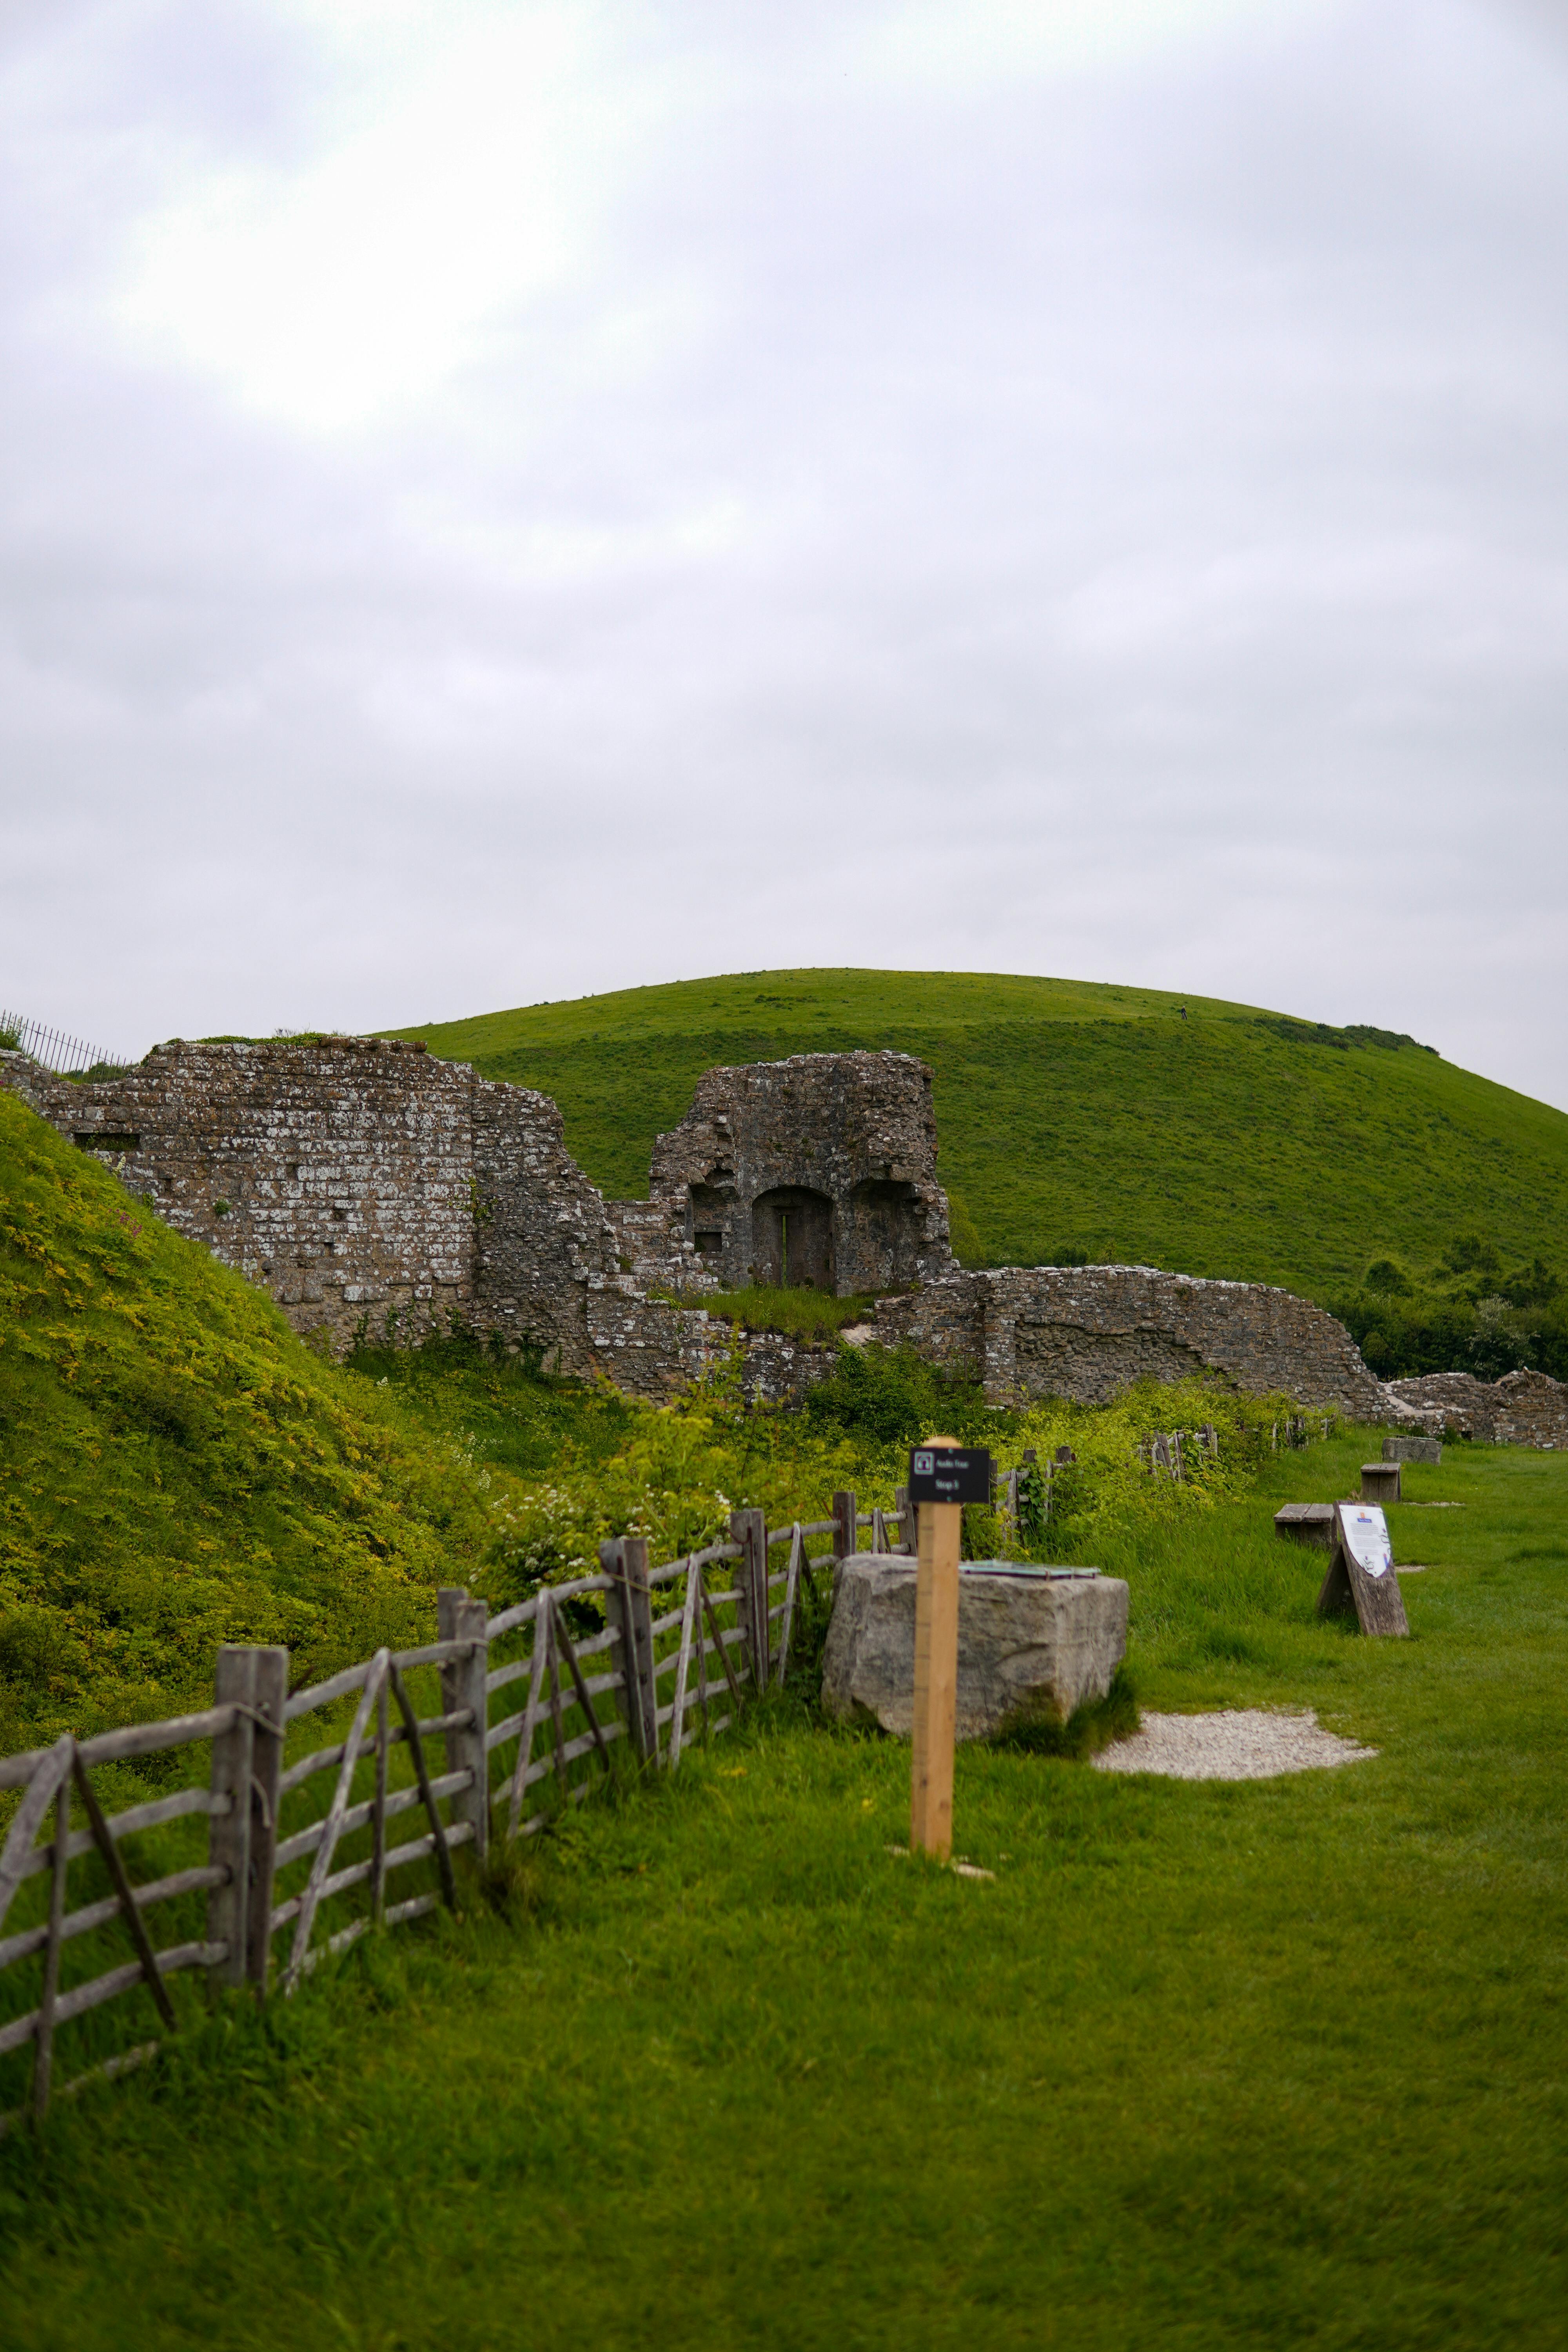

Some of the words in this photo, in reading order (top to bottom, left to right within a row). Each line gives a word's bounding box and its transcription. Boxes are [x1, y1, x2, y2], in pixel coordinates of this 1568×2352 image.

[936, 1459, 953, 1468] Audio
[955, 1459, 969, 1468] Tour
[935, 1479, 952, 1491] Stop
